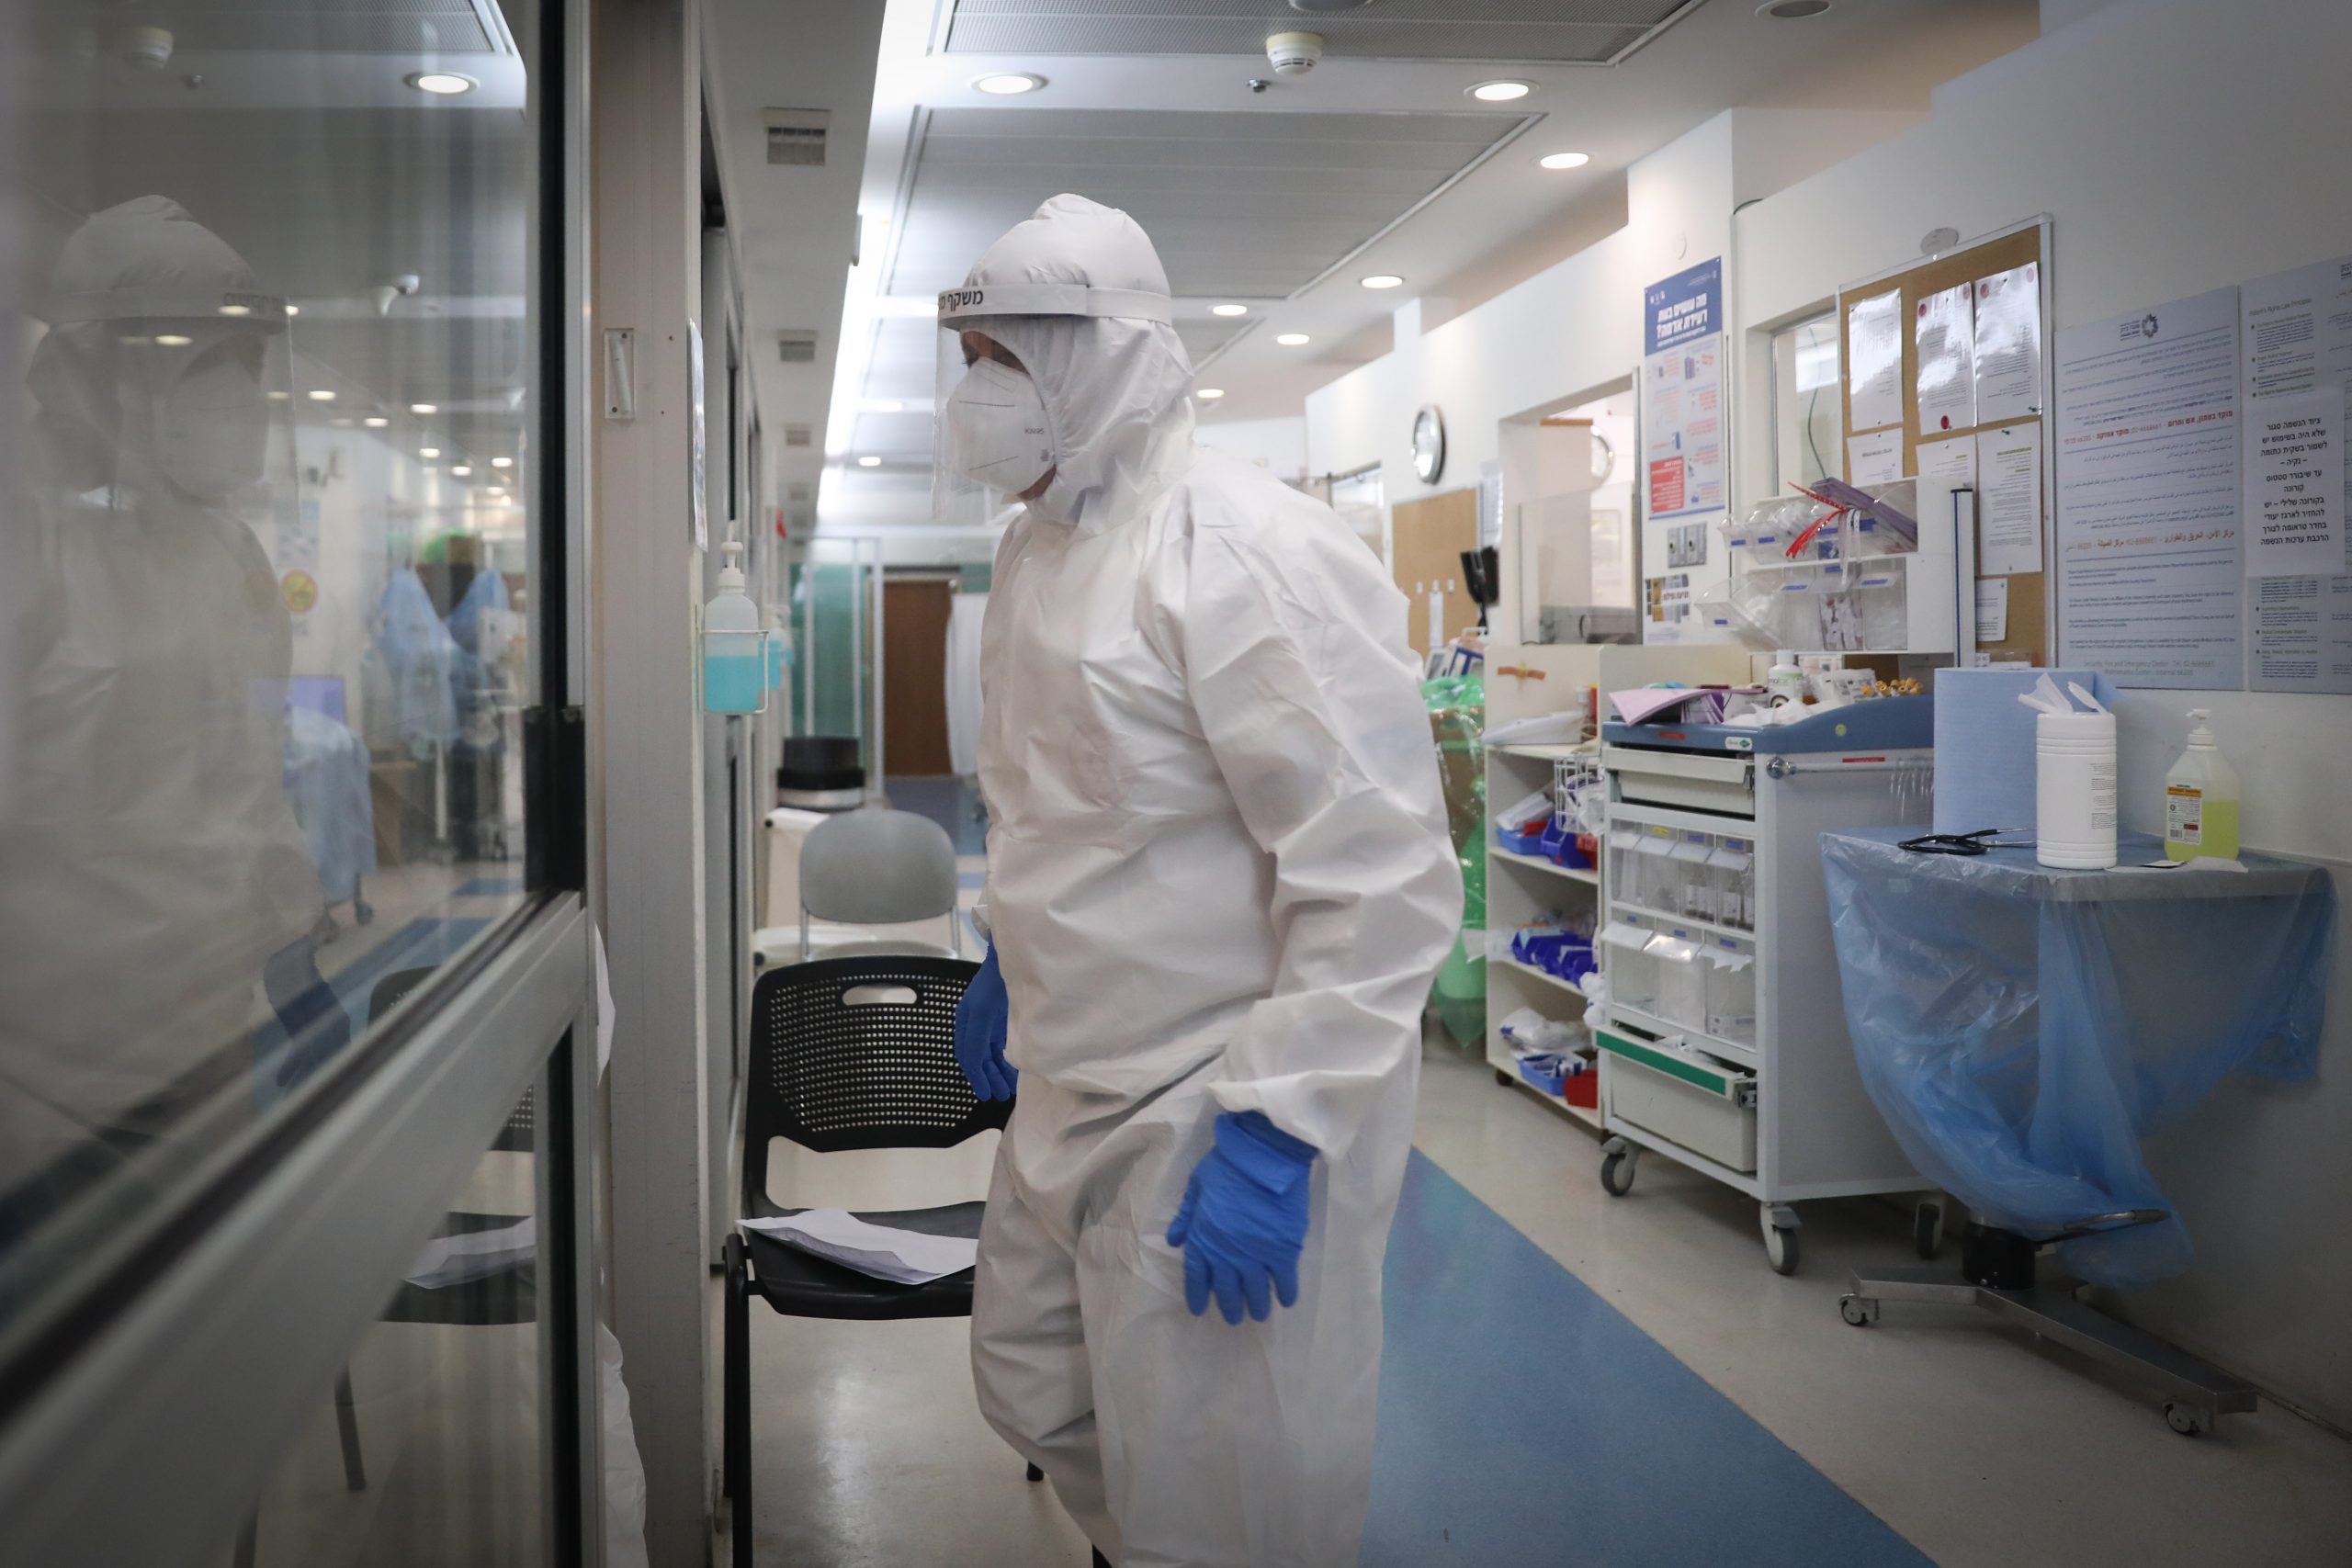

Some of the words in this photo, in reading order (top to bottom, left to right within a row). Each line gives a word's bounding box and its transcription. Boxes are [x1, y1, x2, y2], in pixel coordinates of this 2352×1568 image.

[947, 290, 984, 312] משקף
[2218, 411, 2233, 419] מוקד
[2282, 419, 2306, 429] הנשמה
[2308, 417, 2322, 425] ציוד
[2267, 423, 2281, 431] סגור
[2311, 429, 2326, 437] שלא
[2271, 434, 2296, 443] בשימוש
[2282, 445, 2304, 455] בשקית
[2307, 441, 2327, 450] לשמור
[2286, 458, 2301, 467] נקיה
[2289, 470, 2312, 479] שיבורר
[2283, 484, 2304, 492] קורונה
[2280, 498, 2298, 506] שלילי
[2299, 497, 2324, 505] בקורונה
[2280, 509, 2300, 519] לארגז
[2301, 508, 2324, 517] להחזיר
[2262, 525, 2279, 535] לצורך
[2281, 524, 2307, 532] טראומה
[2260, 537, 2283, 546] הנשמה
[2285, 536, 2305, 544] ערכות
